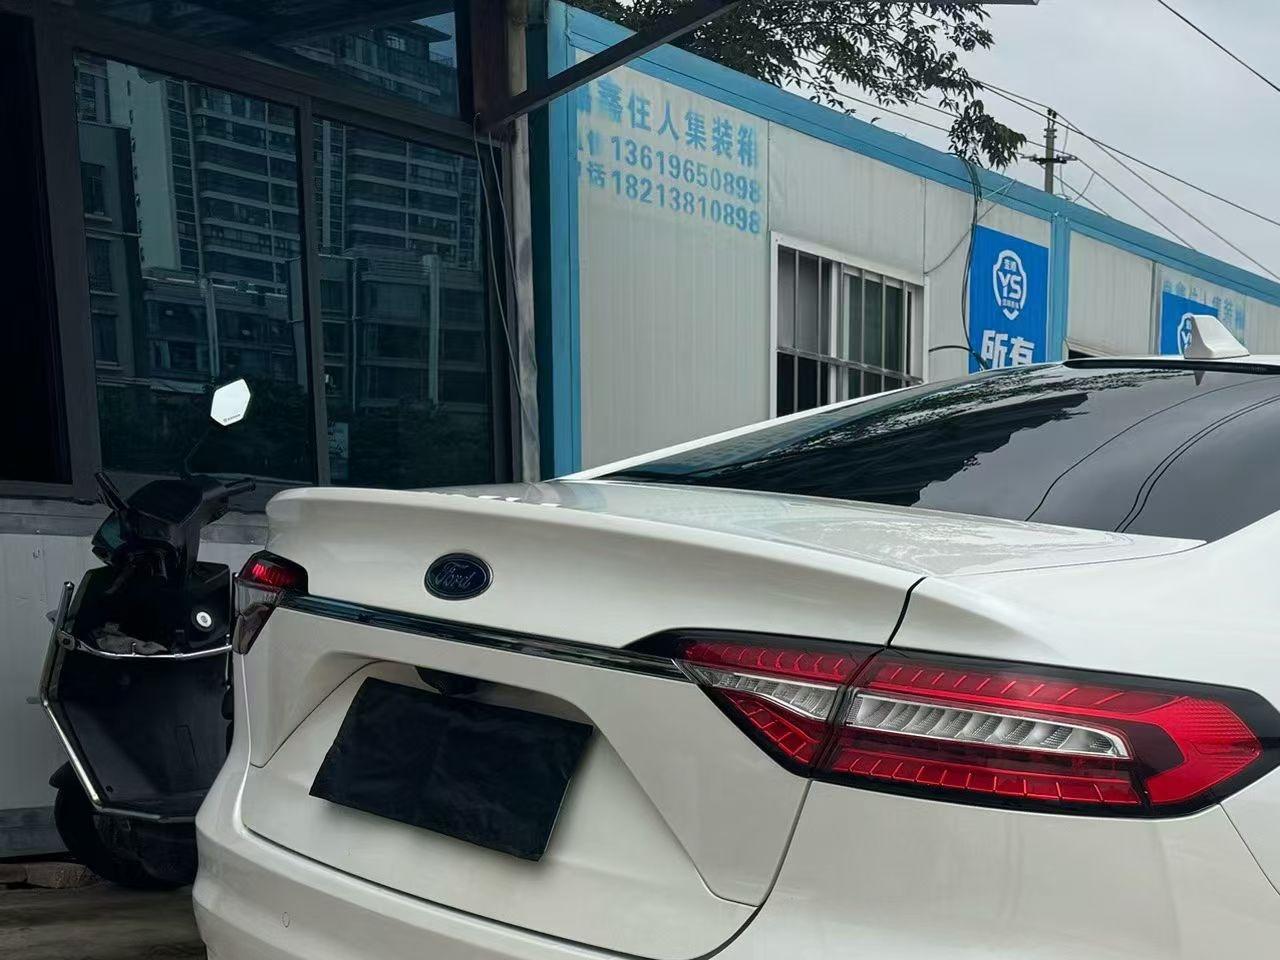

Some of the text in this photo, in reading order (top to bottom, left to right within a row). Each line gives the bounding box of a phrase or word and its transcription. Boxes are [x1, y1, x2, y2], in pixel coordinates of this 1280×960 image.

[611, 135, 761, 204] 13619650898
[611, 170, 761, 234] 18213810898
[998, 271, 1022, 299] YS
[432, 561, 476, 589] Ford
